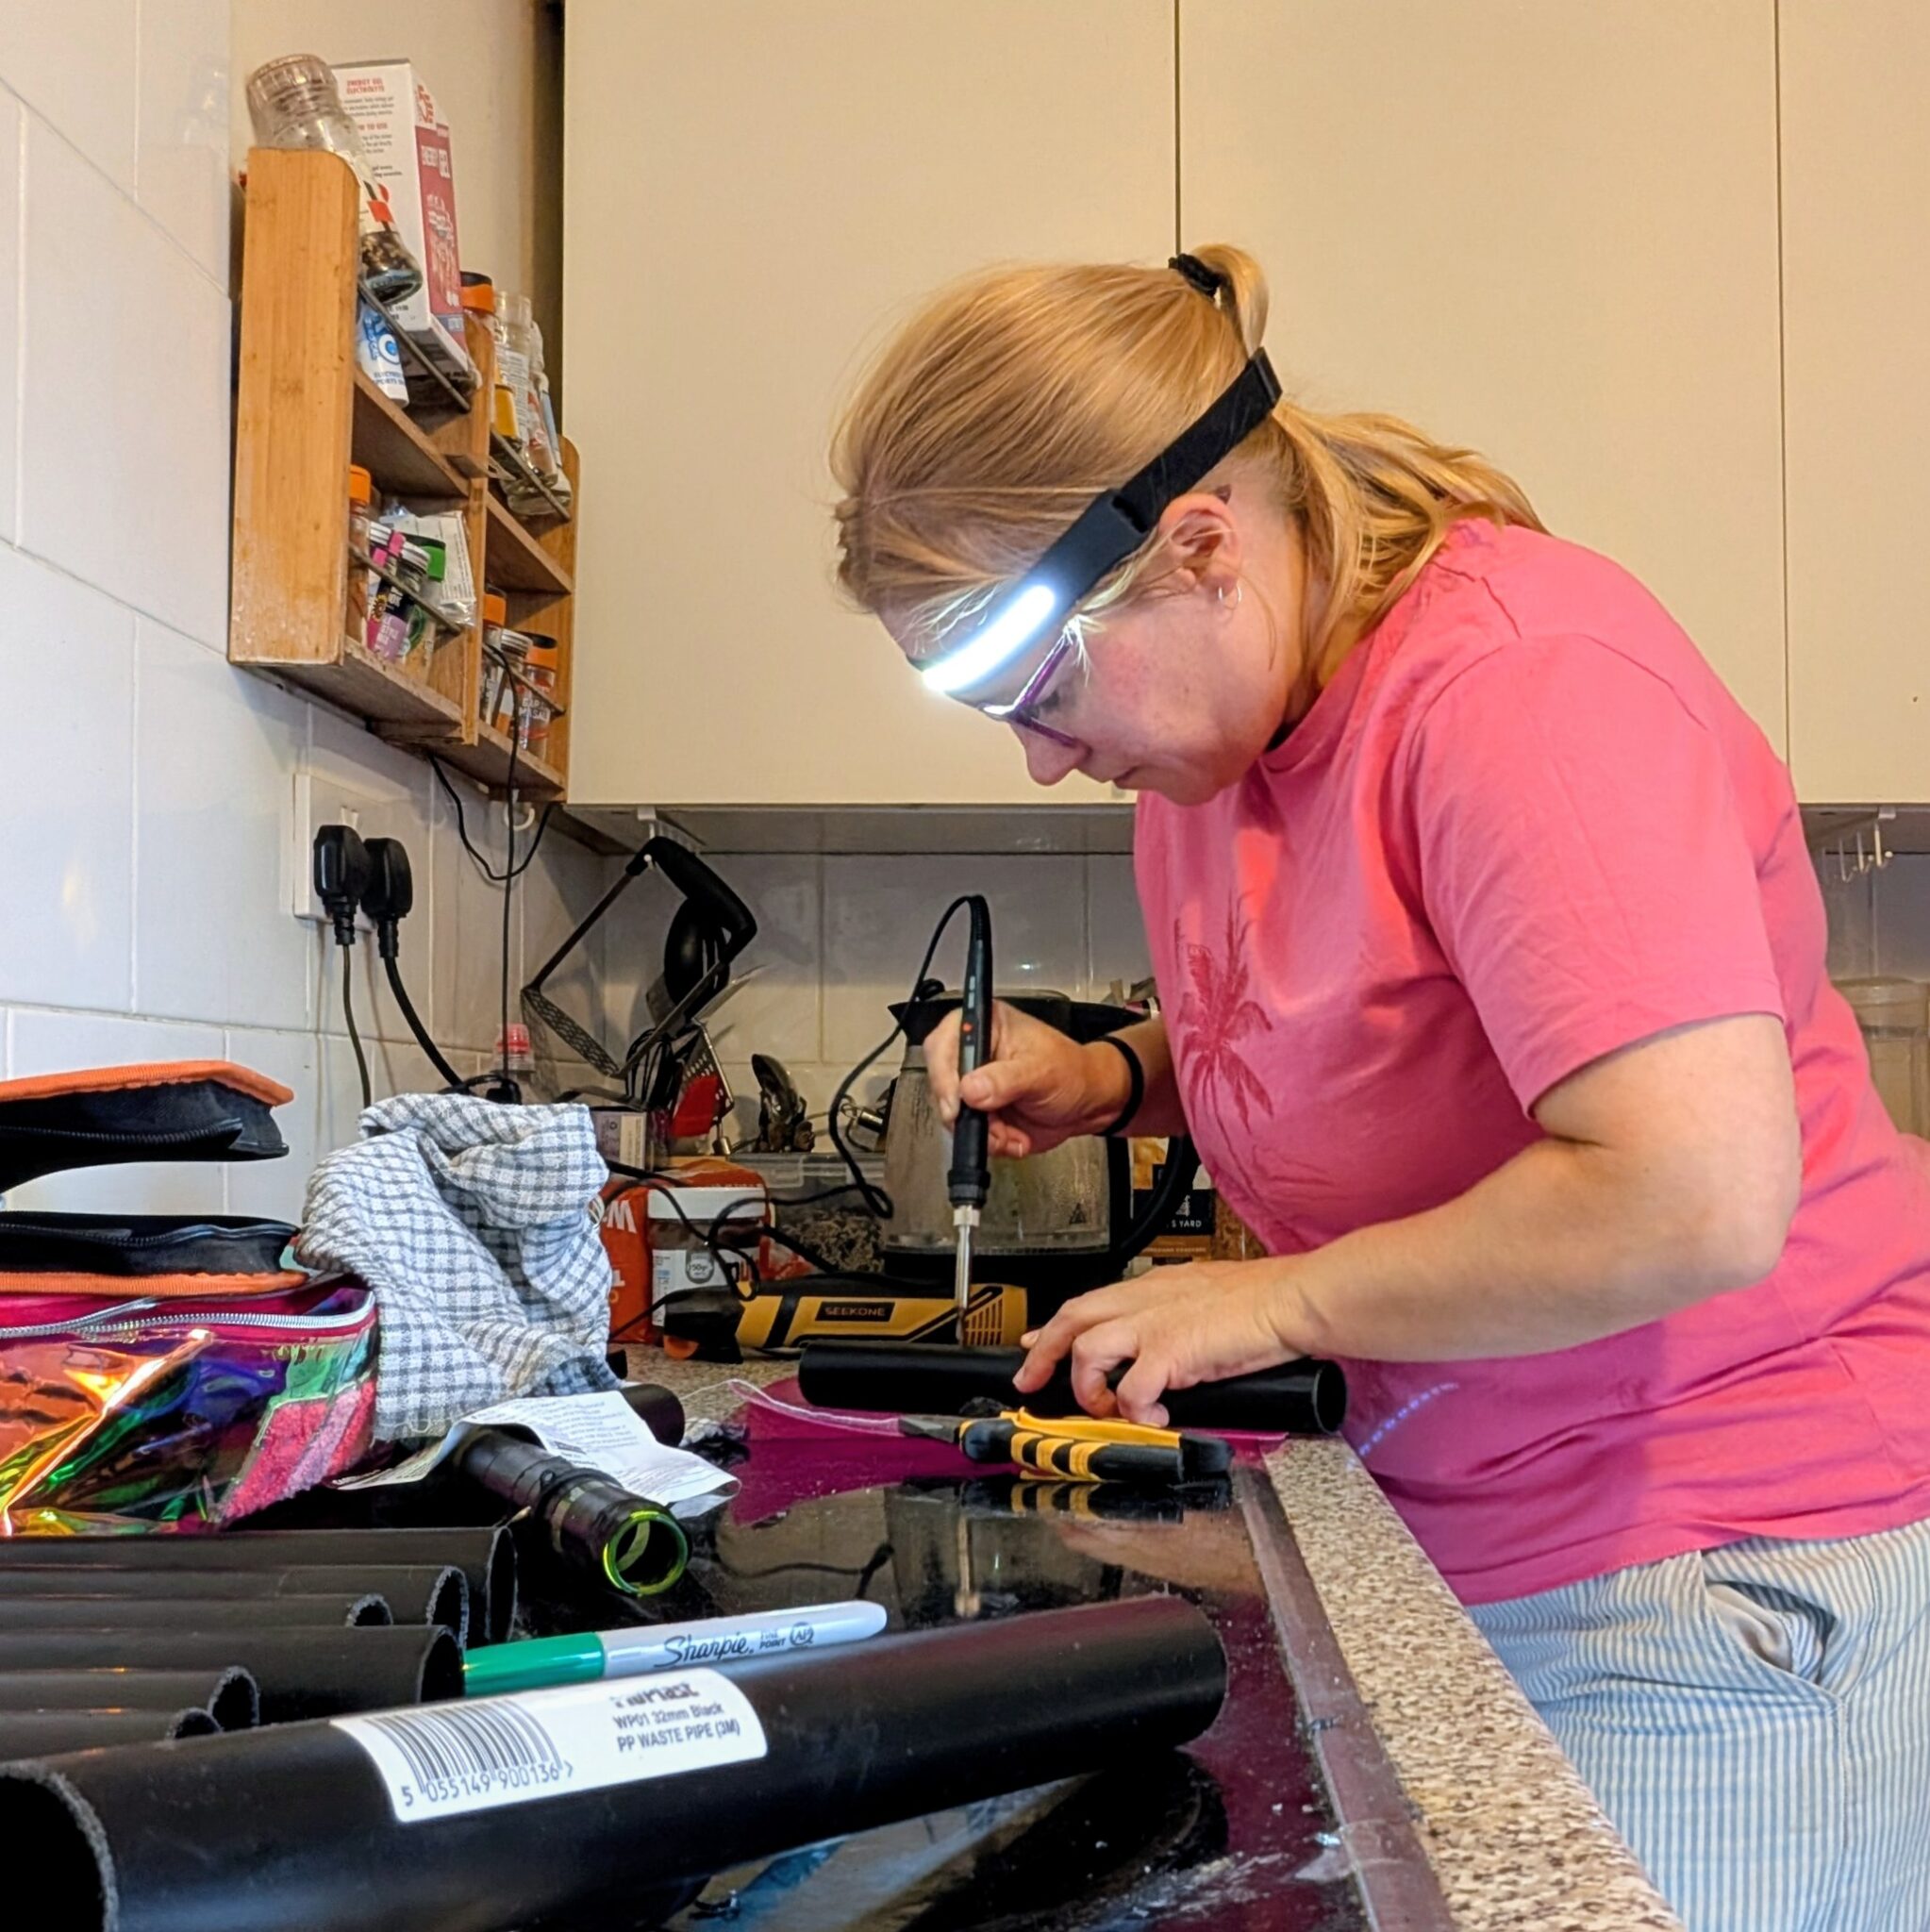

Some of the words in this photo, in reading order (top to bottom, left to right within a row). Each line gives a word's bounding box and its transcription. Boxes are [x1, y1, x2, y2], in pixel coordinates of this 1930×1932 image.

[1178, 1219, 1202, 1227] YARD
[824, 1307, 886, 1316] SEEKONE
[759, 1638, 786, 1650] POINT
[613, 1712, 650, 1729] WP01
[652, 1707, 690, 1724] 32mm
[690, 1703, 724, 1718] Black
[617, 1736, 635, 1752] PP
[639, 1726, 684, 1748] WASTE
[685, 1724, 713, 1740] PIPE
[715, 1718, 740, 1739] (3M)
[401, 1786, 414, 1807] 5
[426, 1774, 491, 1803] 055149
[498, 1763, 560, 1790] 900136
